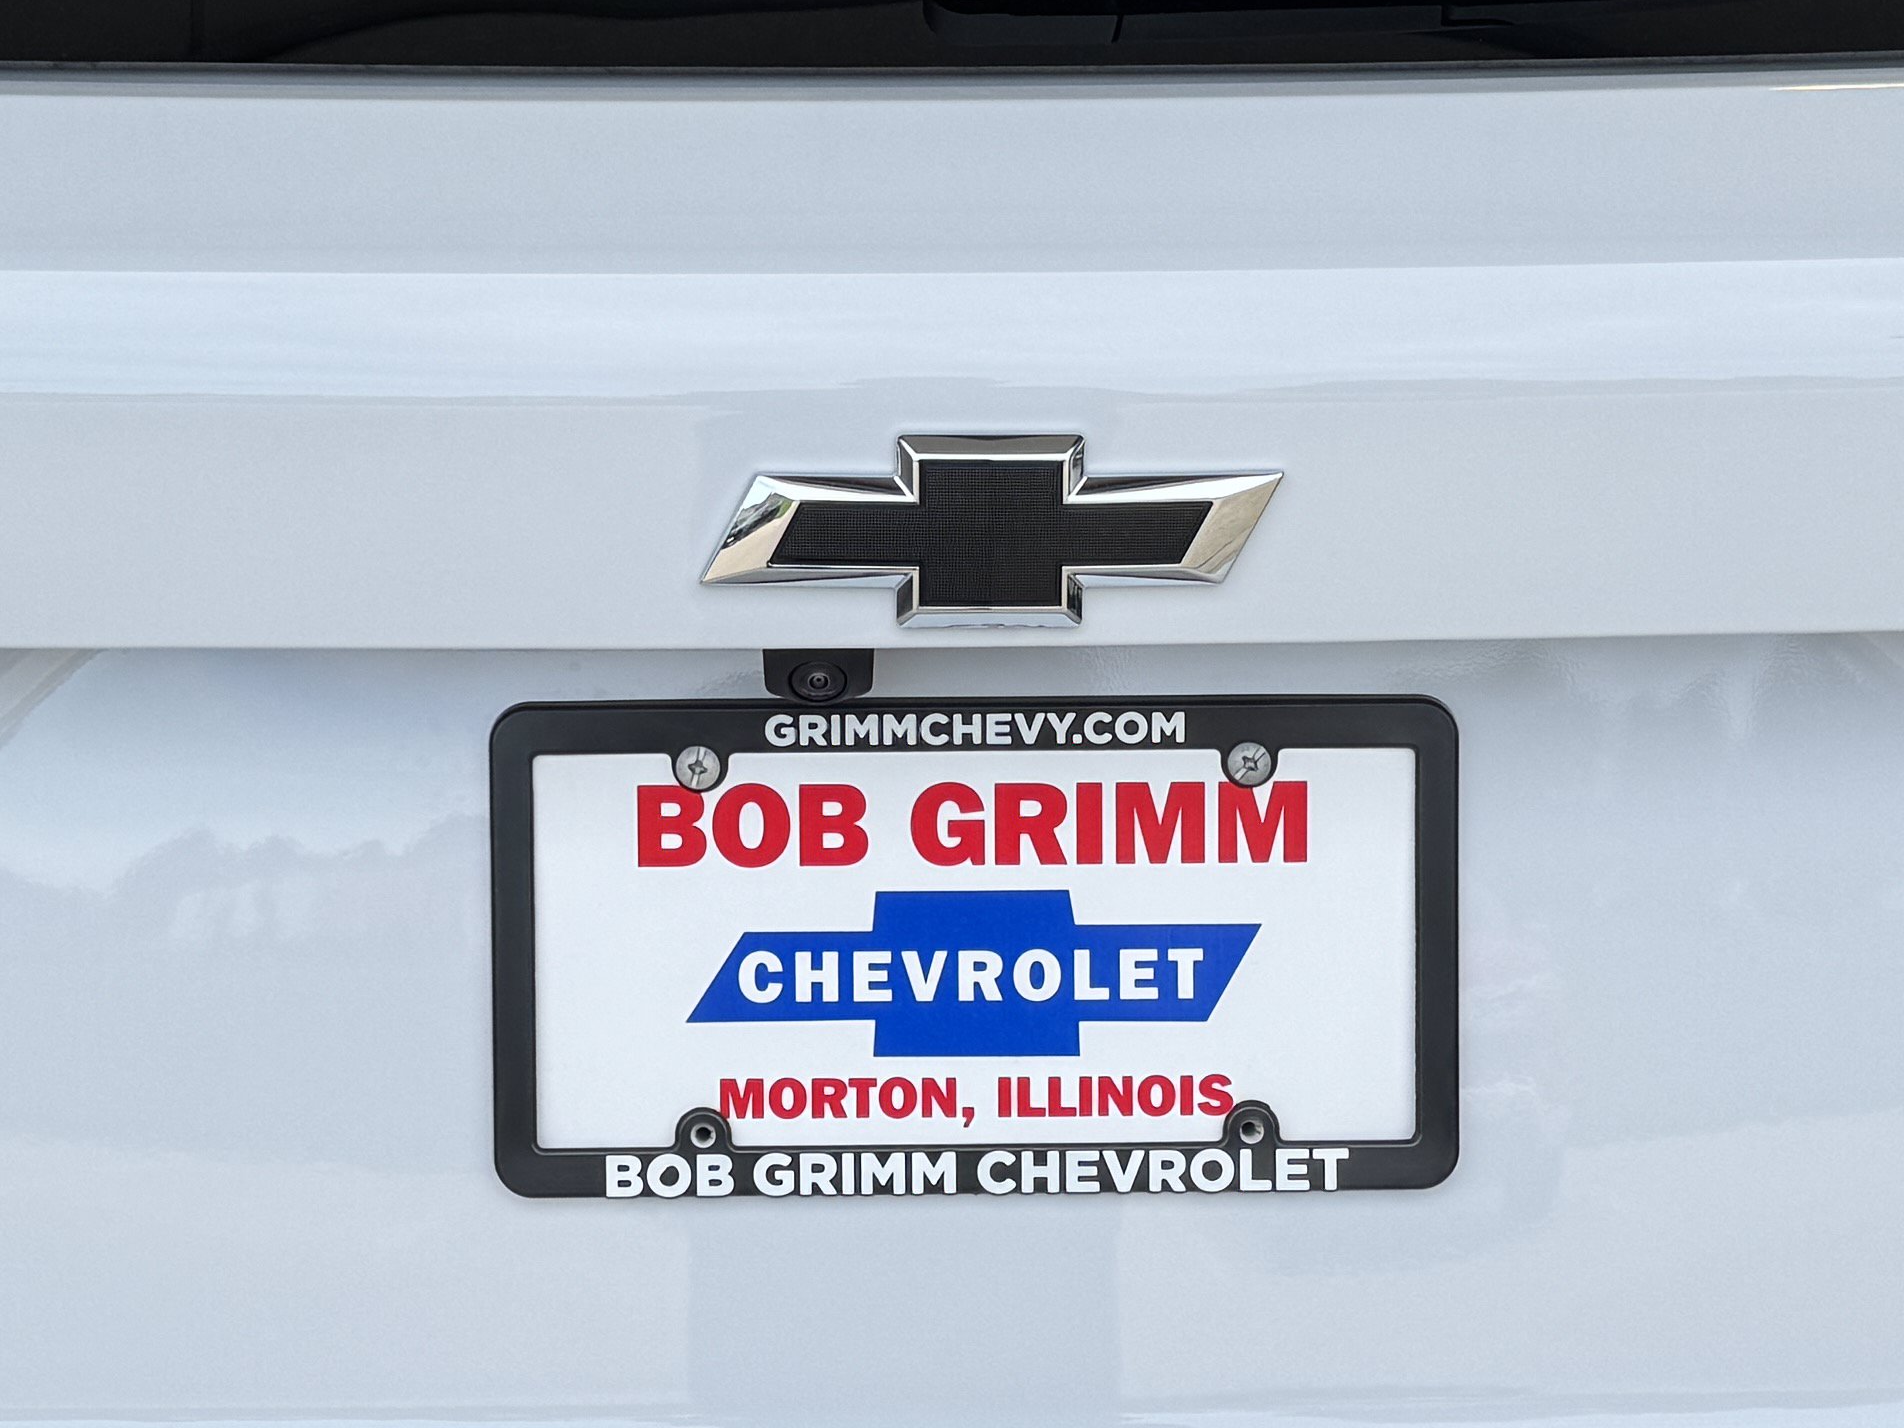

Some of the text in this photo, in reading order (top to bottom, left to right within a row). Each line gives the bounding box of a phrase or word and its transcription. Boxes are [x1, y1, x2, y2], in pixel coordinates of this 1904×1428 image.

[763, 711, 1186, 747] GRIMMCHEVY.COM
[636, 780, 1309, 868] BOB GRIMM
[737, 948, 1205, 1003] CHEVROLET
[718, 1073, 1234, 1128] MORTON, ILLINOIS
[604, 1147, 1351, 1200] BOB GRIMM CHEVROLET
